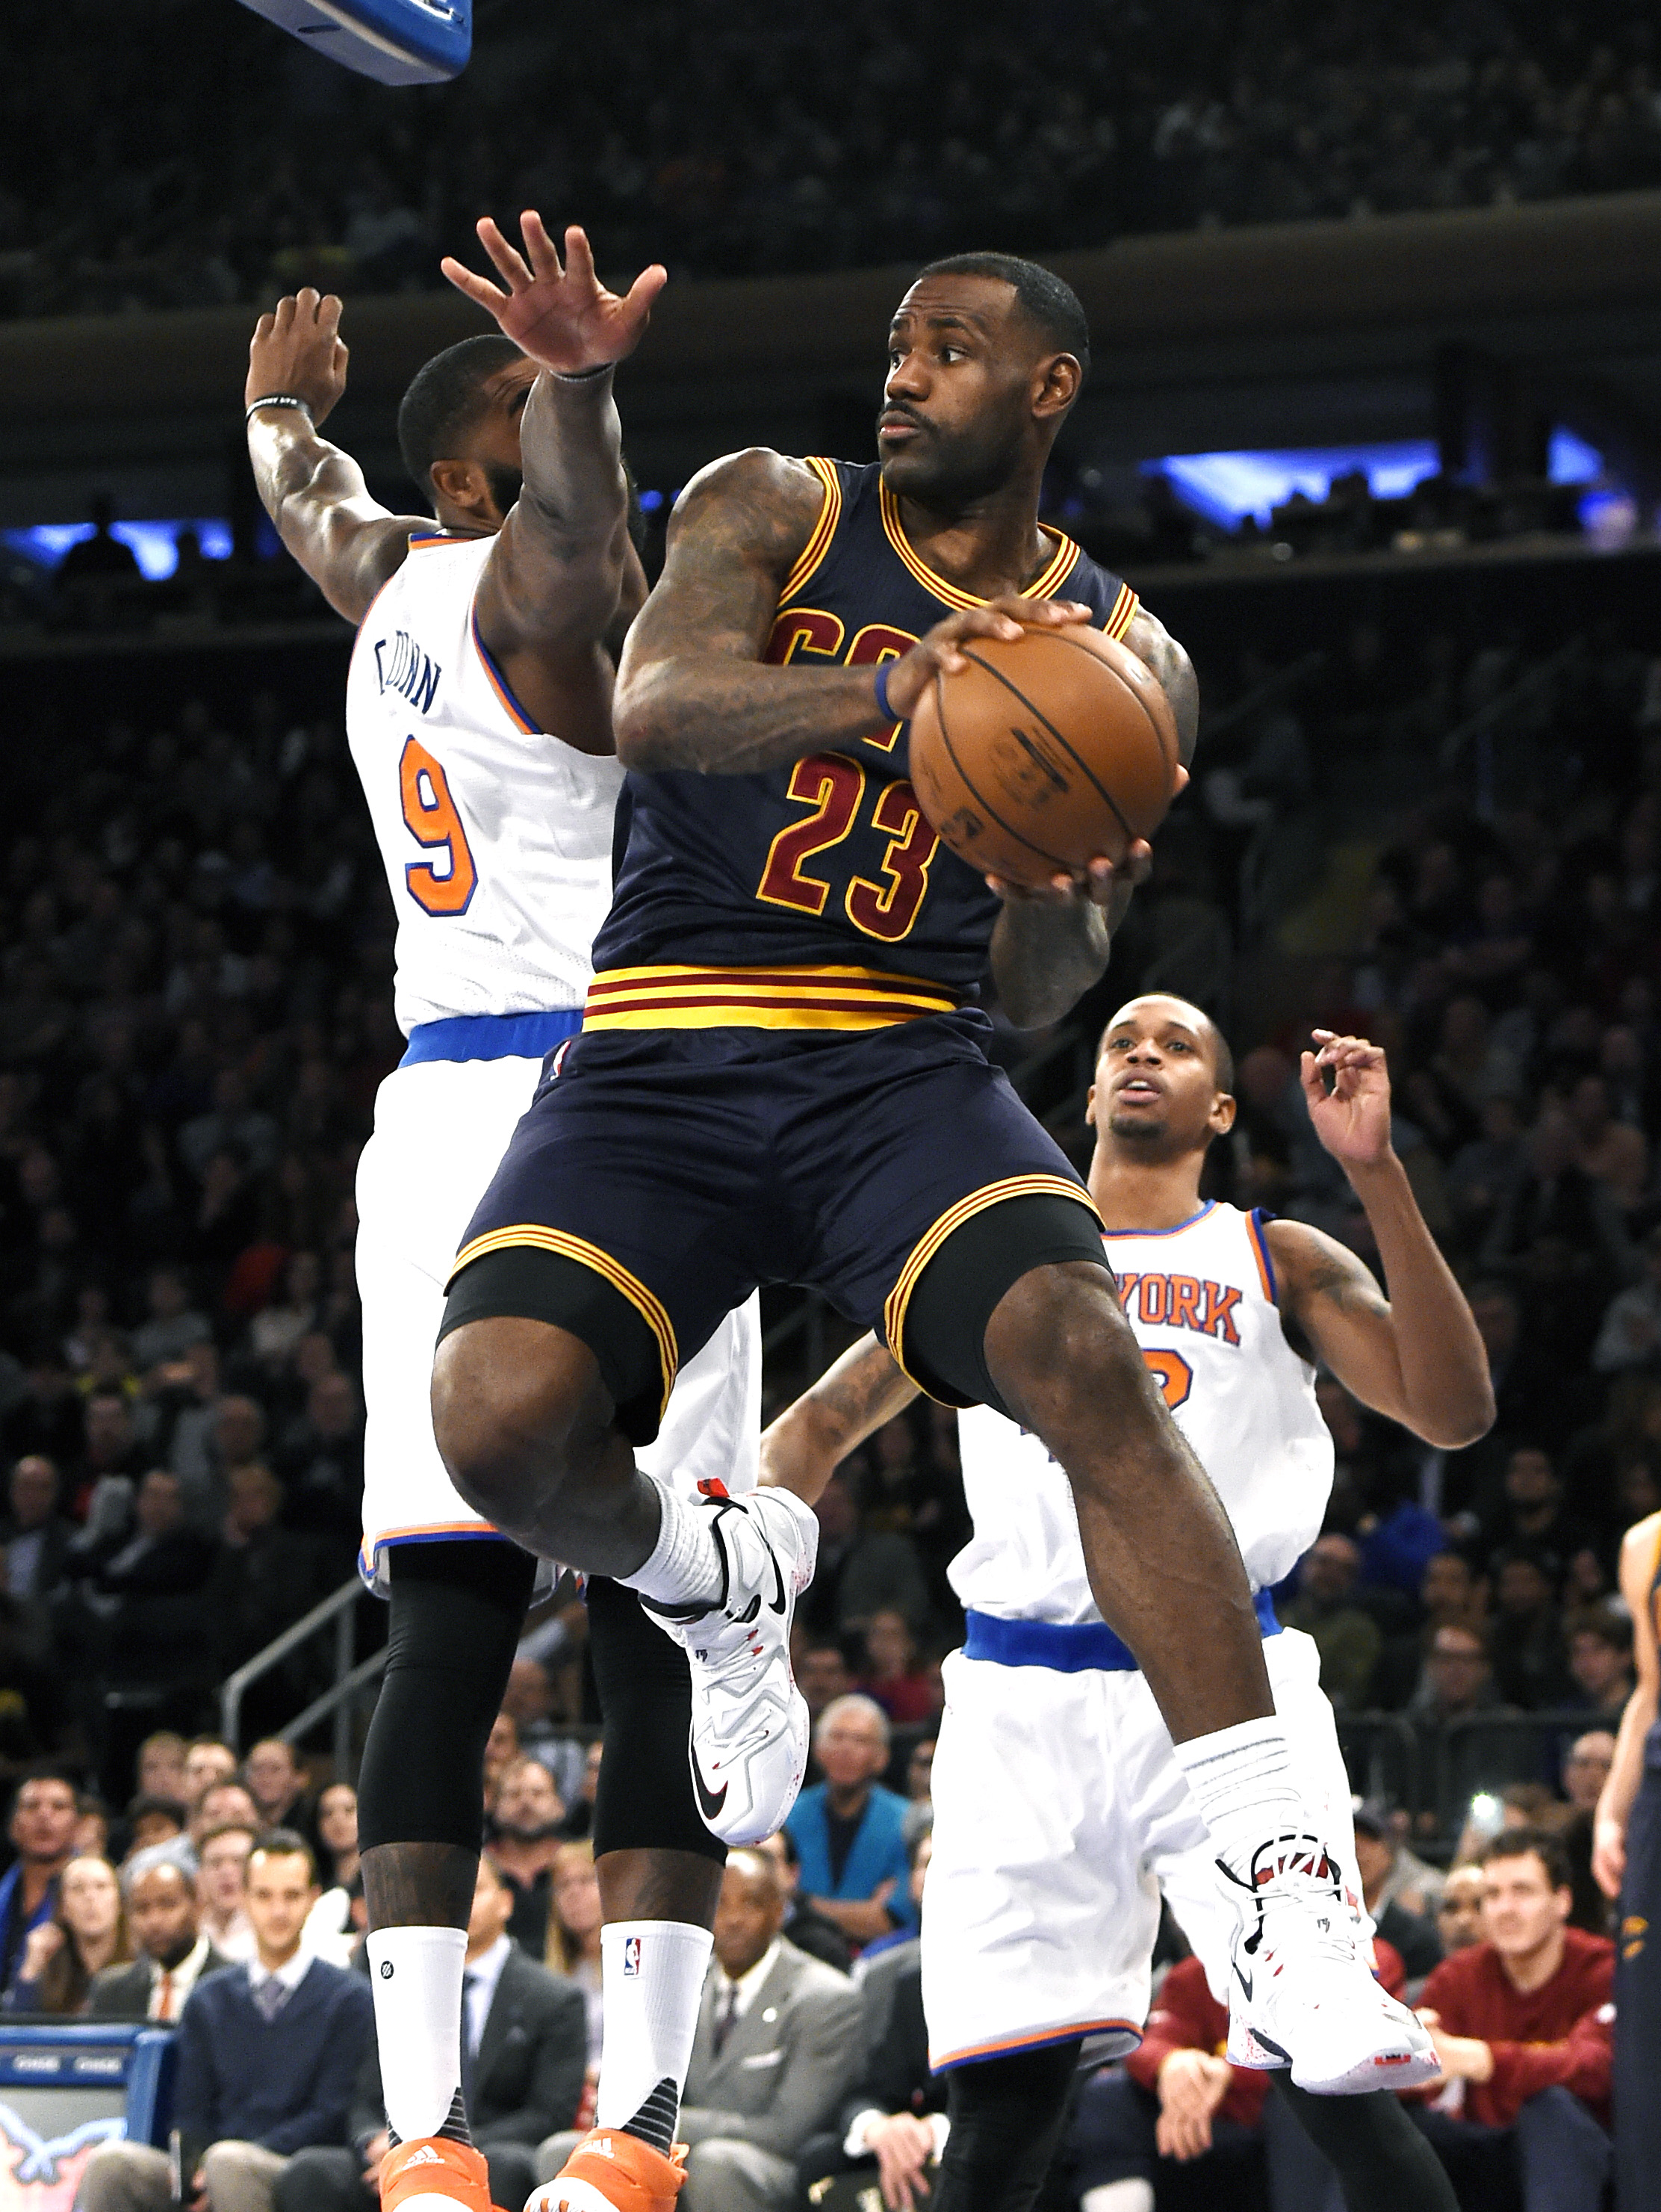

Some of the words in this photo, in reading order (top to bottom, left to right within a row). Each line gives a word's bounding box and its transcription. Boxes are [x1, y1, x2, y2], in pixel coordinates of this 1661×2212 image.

[399, 734, 479, 917] 9
[756, 751, 941, 943] 23
[1114, 1272, 1243, 1347] YORK
